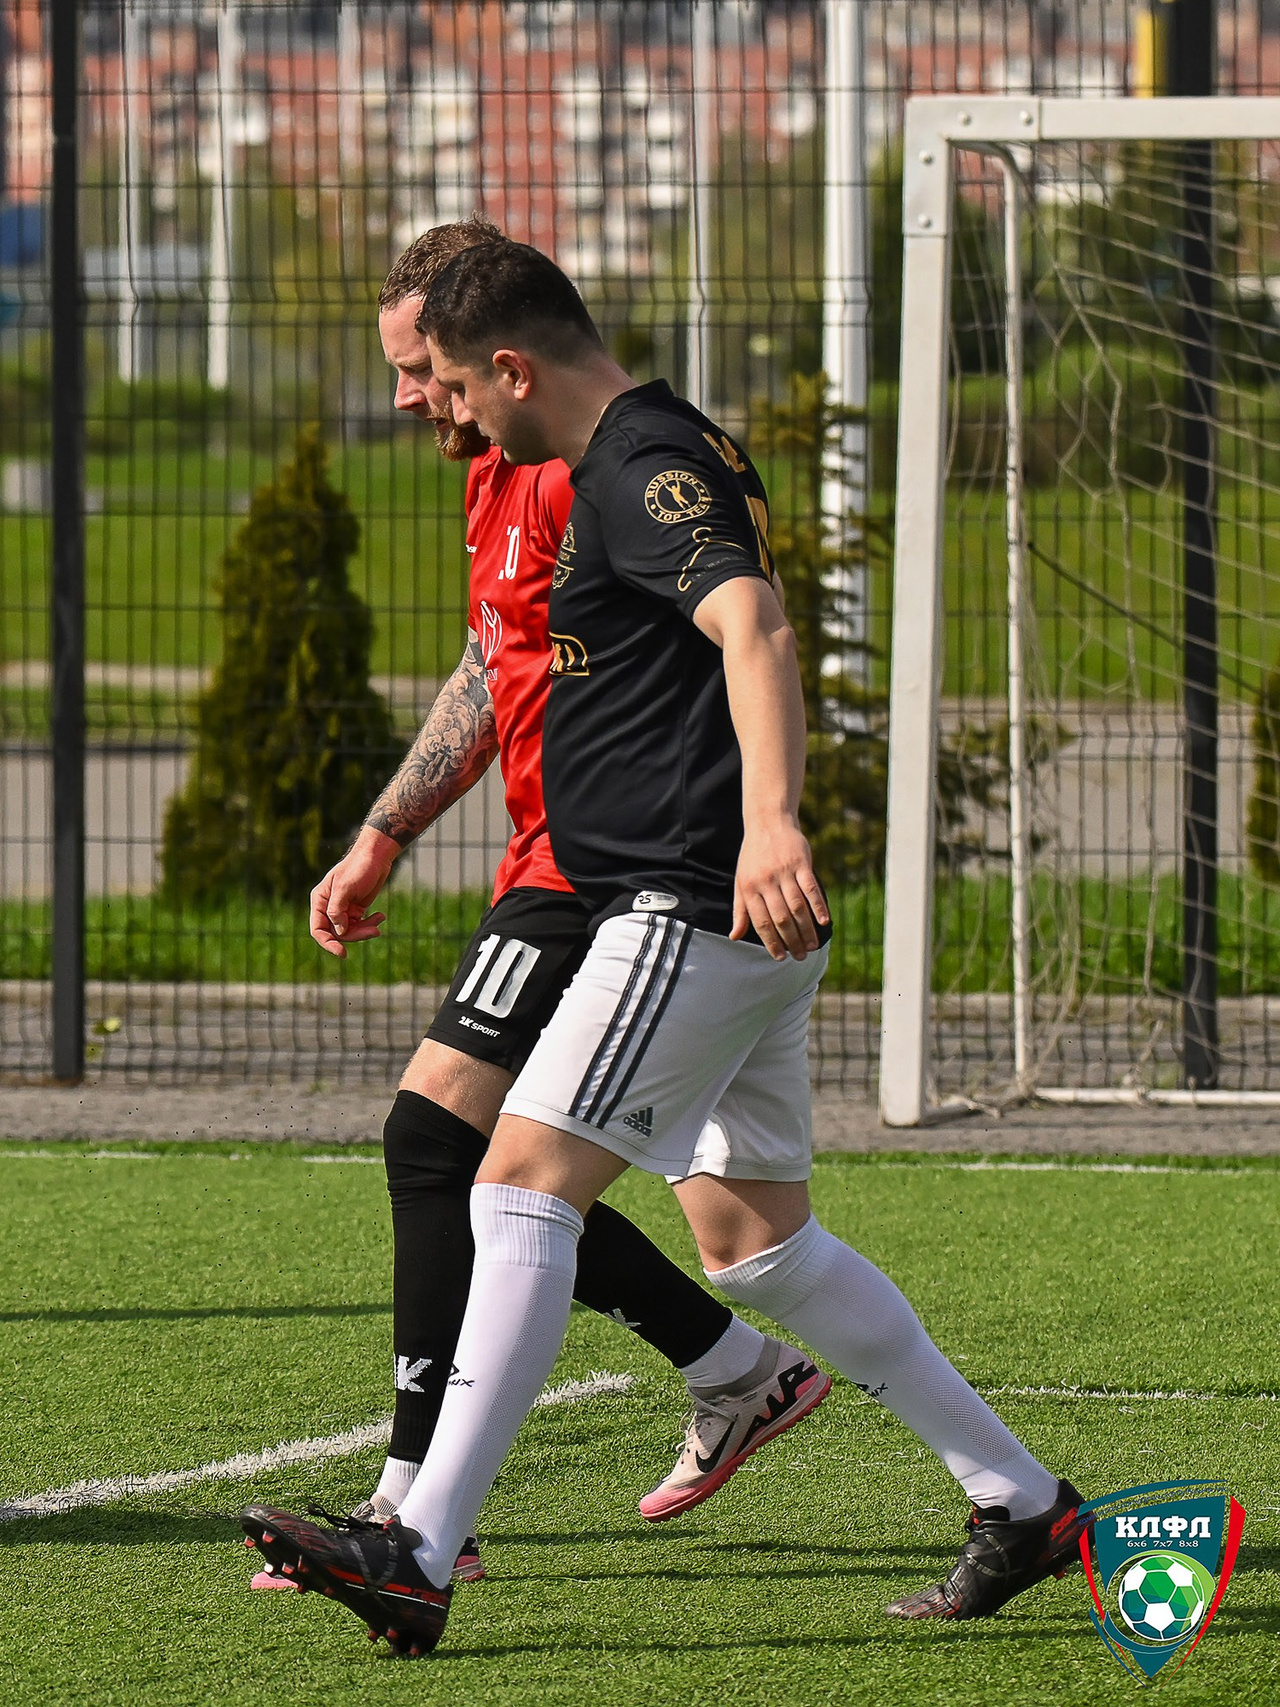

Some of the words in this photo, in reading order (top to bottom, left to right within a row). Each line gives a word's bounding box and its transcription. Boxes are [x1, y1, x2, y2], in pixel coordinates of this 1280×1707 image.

[646, 472, 698, 499] RUSSION
[657, 510, 681, 522] TOP
[455, 933, 541, 1018] 10
[470, 1022, 500, 1037] SPORT
